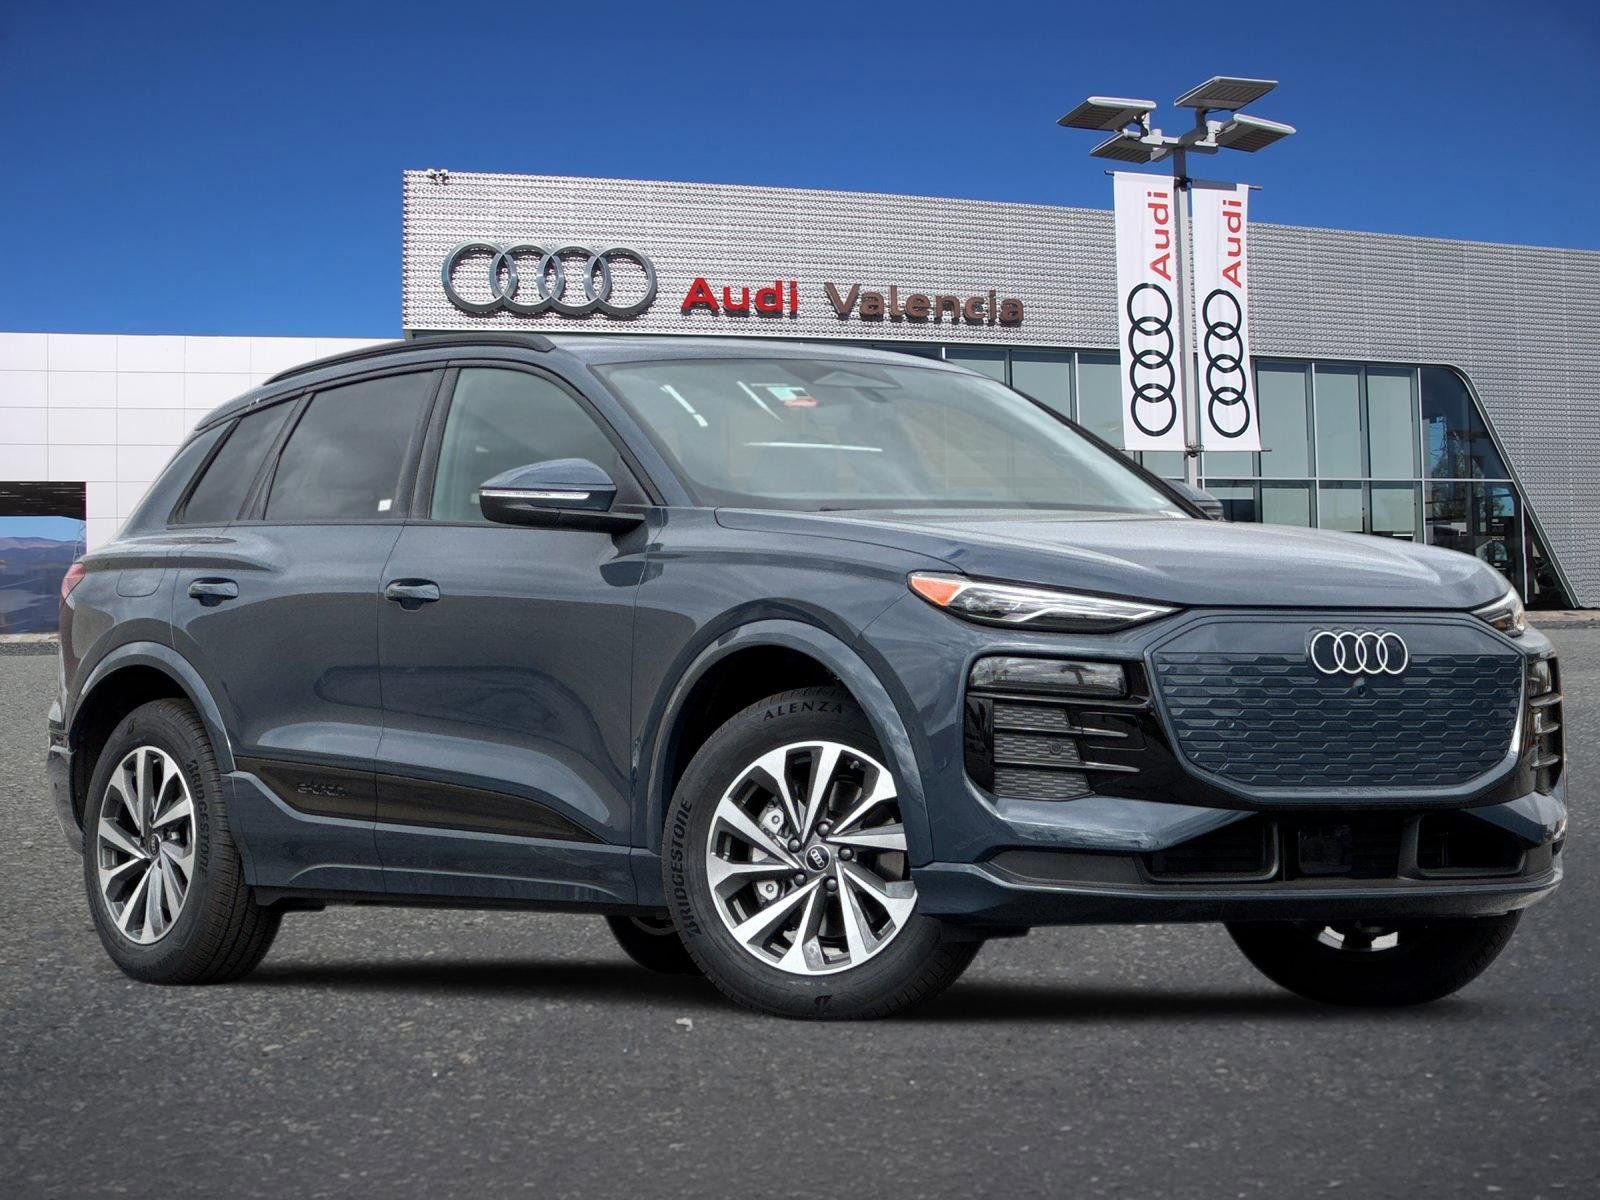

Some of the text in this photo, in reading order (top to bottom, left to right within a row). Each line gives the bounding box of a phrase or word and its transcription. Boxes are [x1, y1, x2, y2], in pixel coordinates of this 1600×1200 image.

[1147, 191, 1172, 282] Audi
[1222, 199, 1243, 289] Audi
[681, 277, 1024, 326] Audi Valencia
[763, 701, 843, 721] ALENZA
